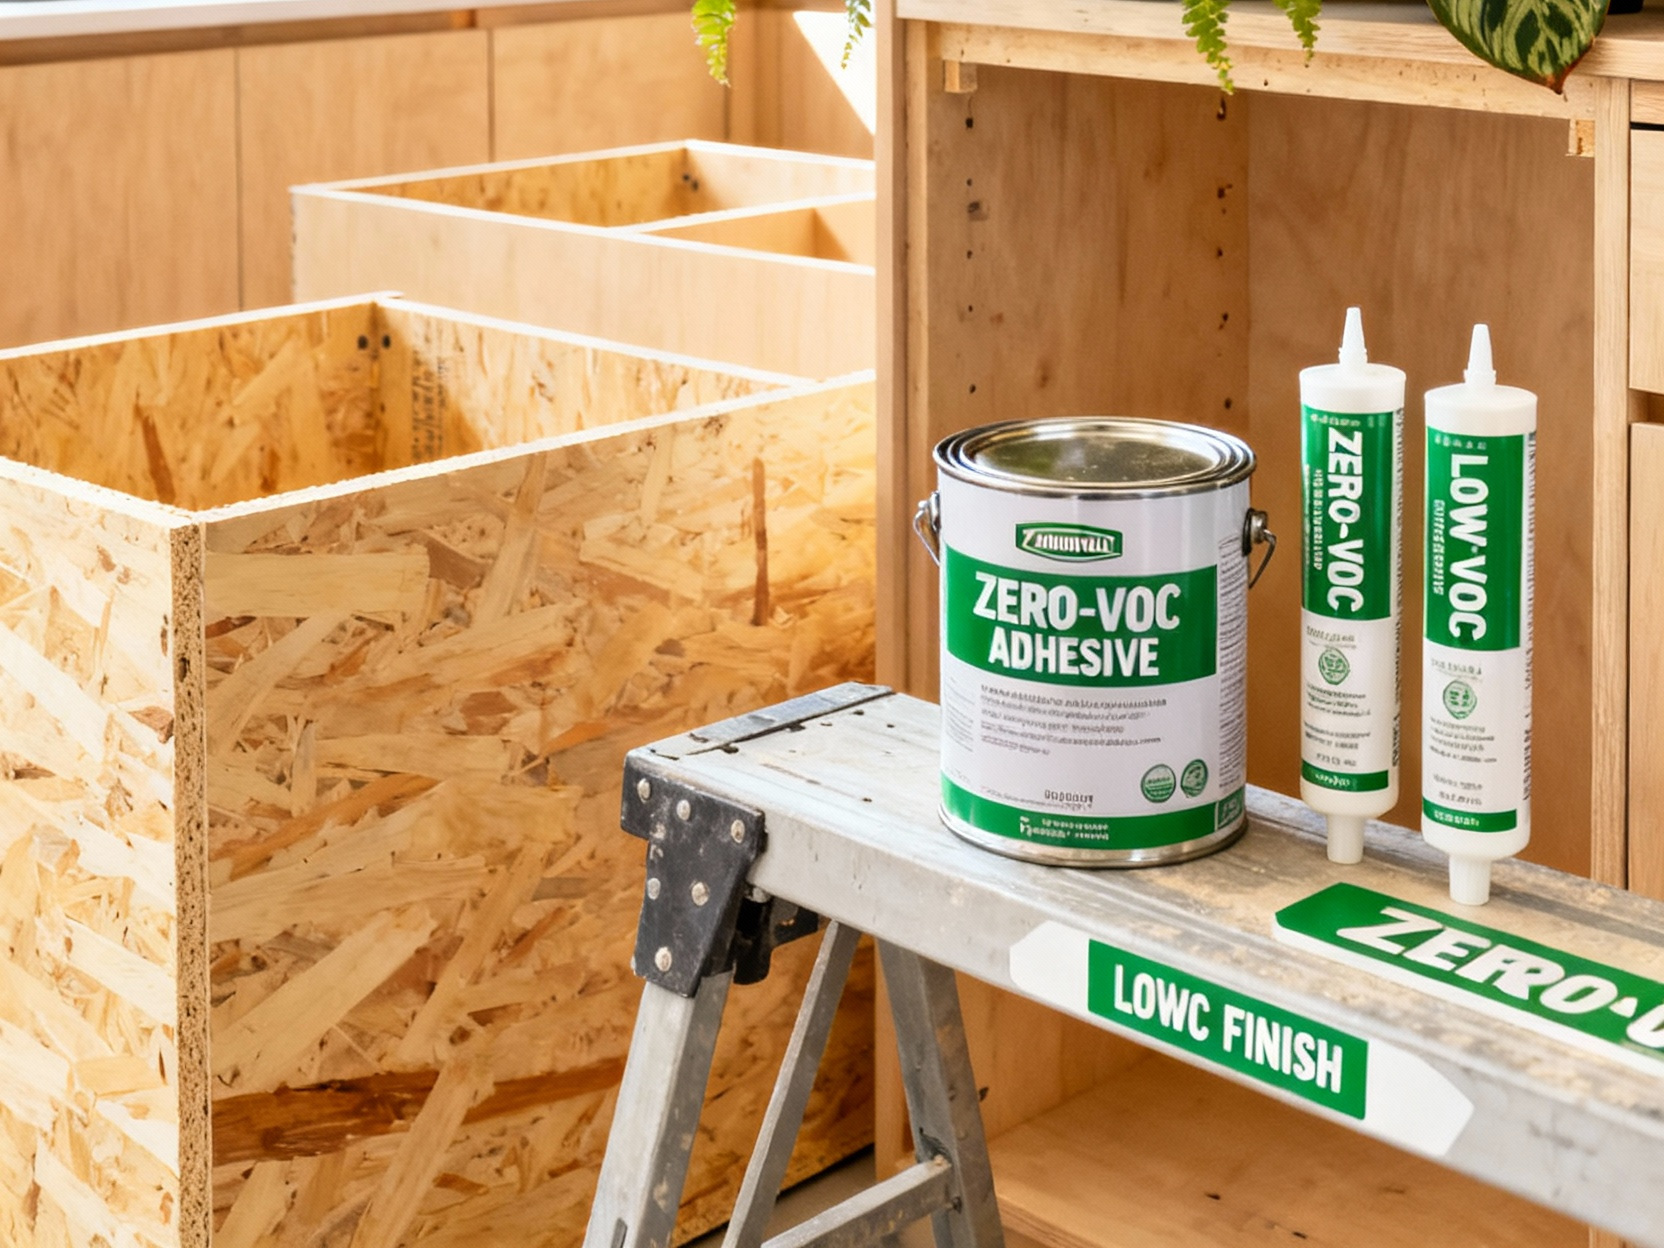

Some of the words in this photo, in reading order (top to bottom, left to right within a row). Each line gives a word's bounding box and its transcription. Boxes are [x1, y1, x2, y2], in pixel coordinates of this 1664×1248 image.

[1326, 426, 1365, 613] ZERO-VOC
[972, 570, 1182, 633] ZERO-VOC
[987, 625, 1160, 678] ADHESIVE
[1113, 963, 1211, 1042] LOWC
[1222, 1003, 1344, 1094] FINISH
